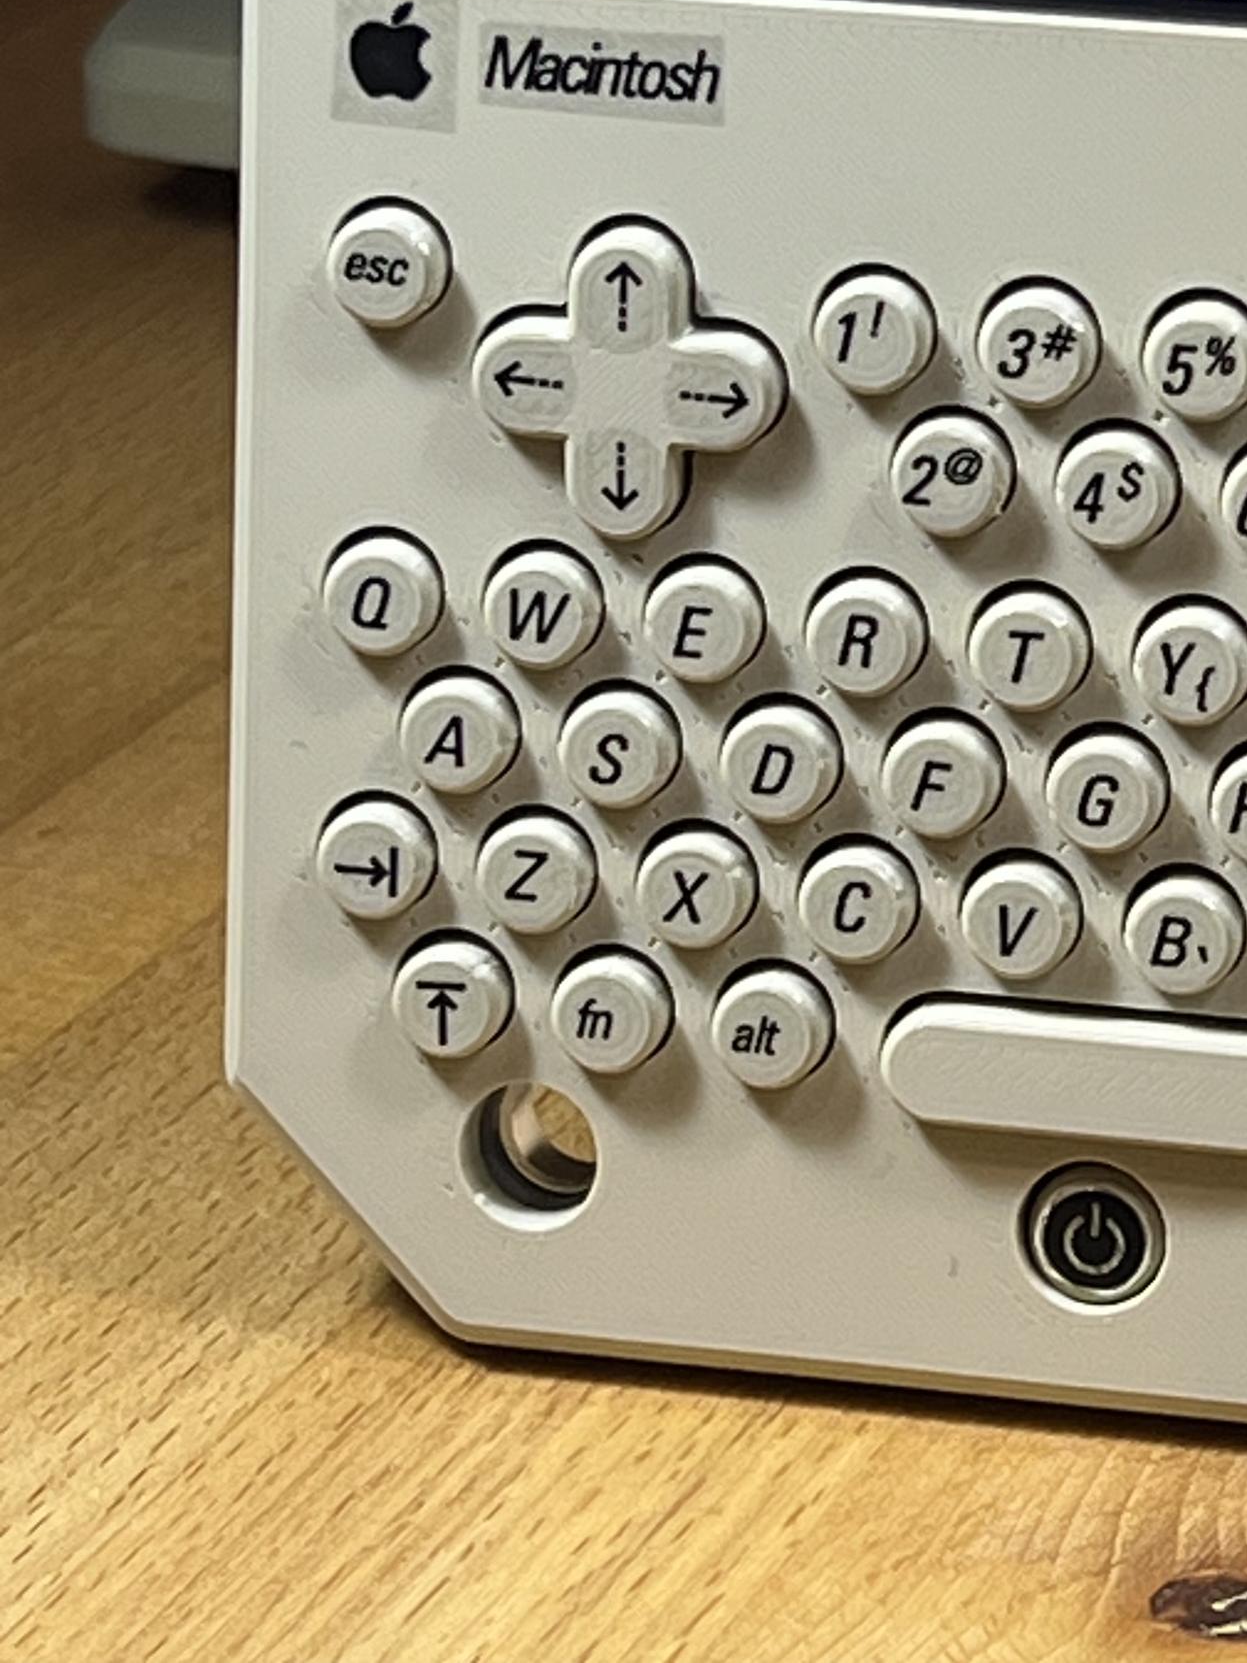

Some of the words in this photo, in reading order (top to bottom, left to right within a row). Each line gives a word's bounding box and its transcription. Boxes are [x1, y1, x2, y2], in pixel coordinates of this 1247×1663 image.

[484, 34, 722, 105] Macintosh
[343, 252, 410, 287] esc
[351, 576, 392, 631] Q
[508, 587, 571, 644] W
[672, 605, 714, 660] E
[837, 613, 879, 669] R
[1008, 629, 1046, 685] T
[423, 715, 465, 768] A
[588, 733, 629, 785] S
[750, 743, 795, 796] D
[910, 759, 953, 812] F
[1077, 774, 1120, 828] G
[504, 849, 549, 903] Z
[662, 870, 710, 925] X
[833, 881, 872, 934] C
[998, 904, 1039, 957] V
[576, 997, 614, 1041] fn
[731, 1015, 781, 1057] alt
